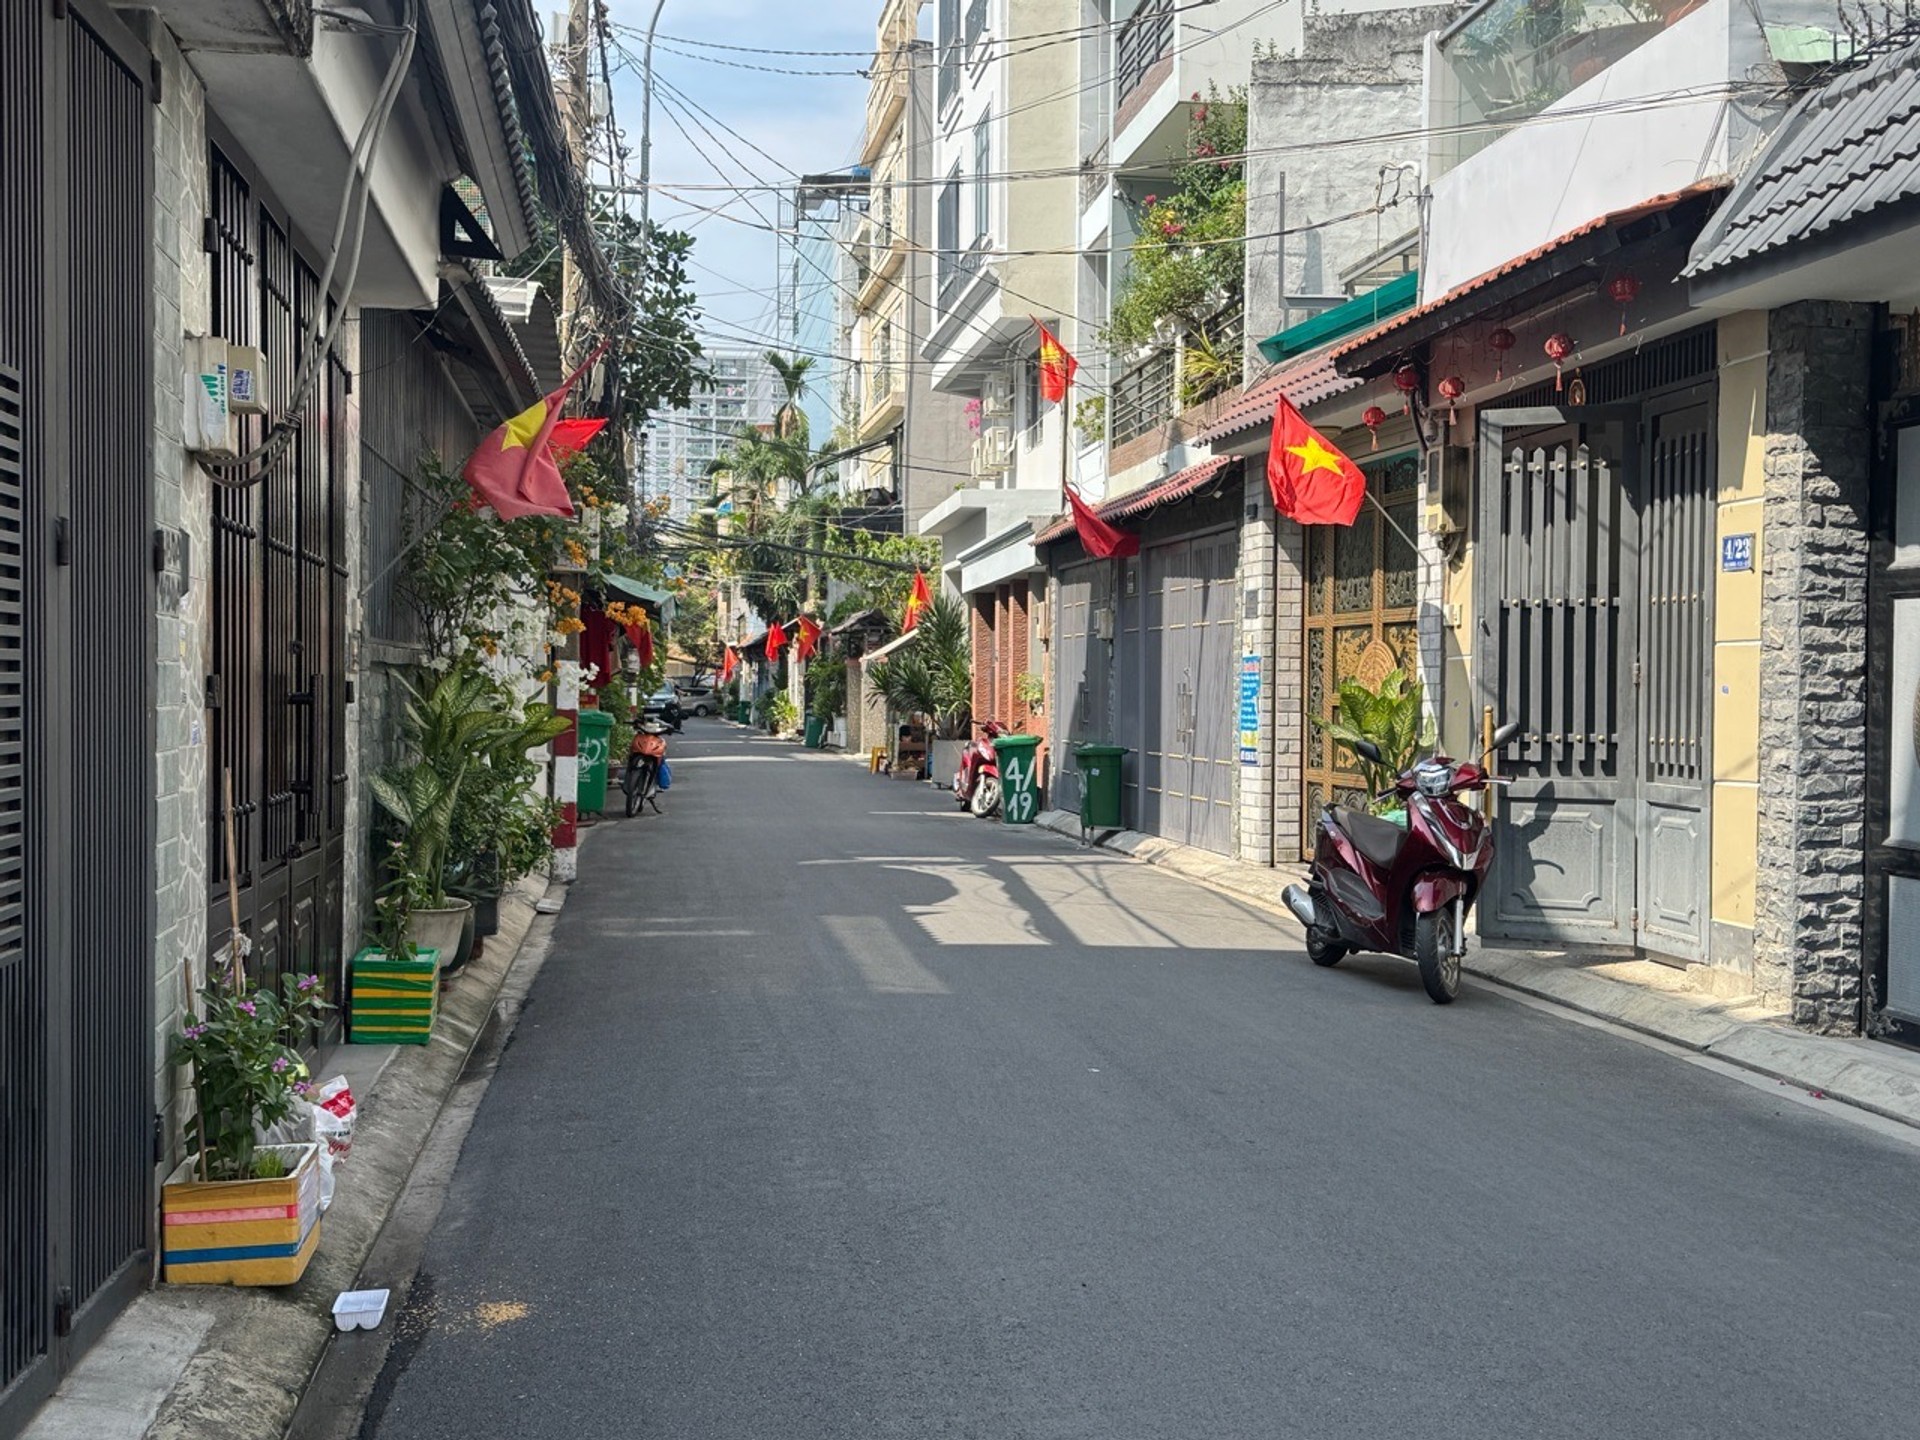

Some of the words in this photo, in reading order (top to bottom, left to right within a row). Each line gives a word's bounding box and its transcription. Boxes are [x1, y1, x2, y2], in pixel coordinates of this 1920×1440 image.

[1724, 538, 1750, 561] 4/23
[1005, 756, 1036, 792] 4/
[1007, 791, 1033, 821] 19
